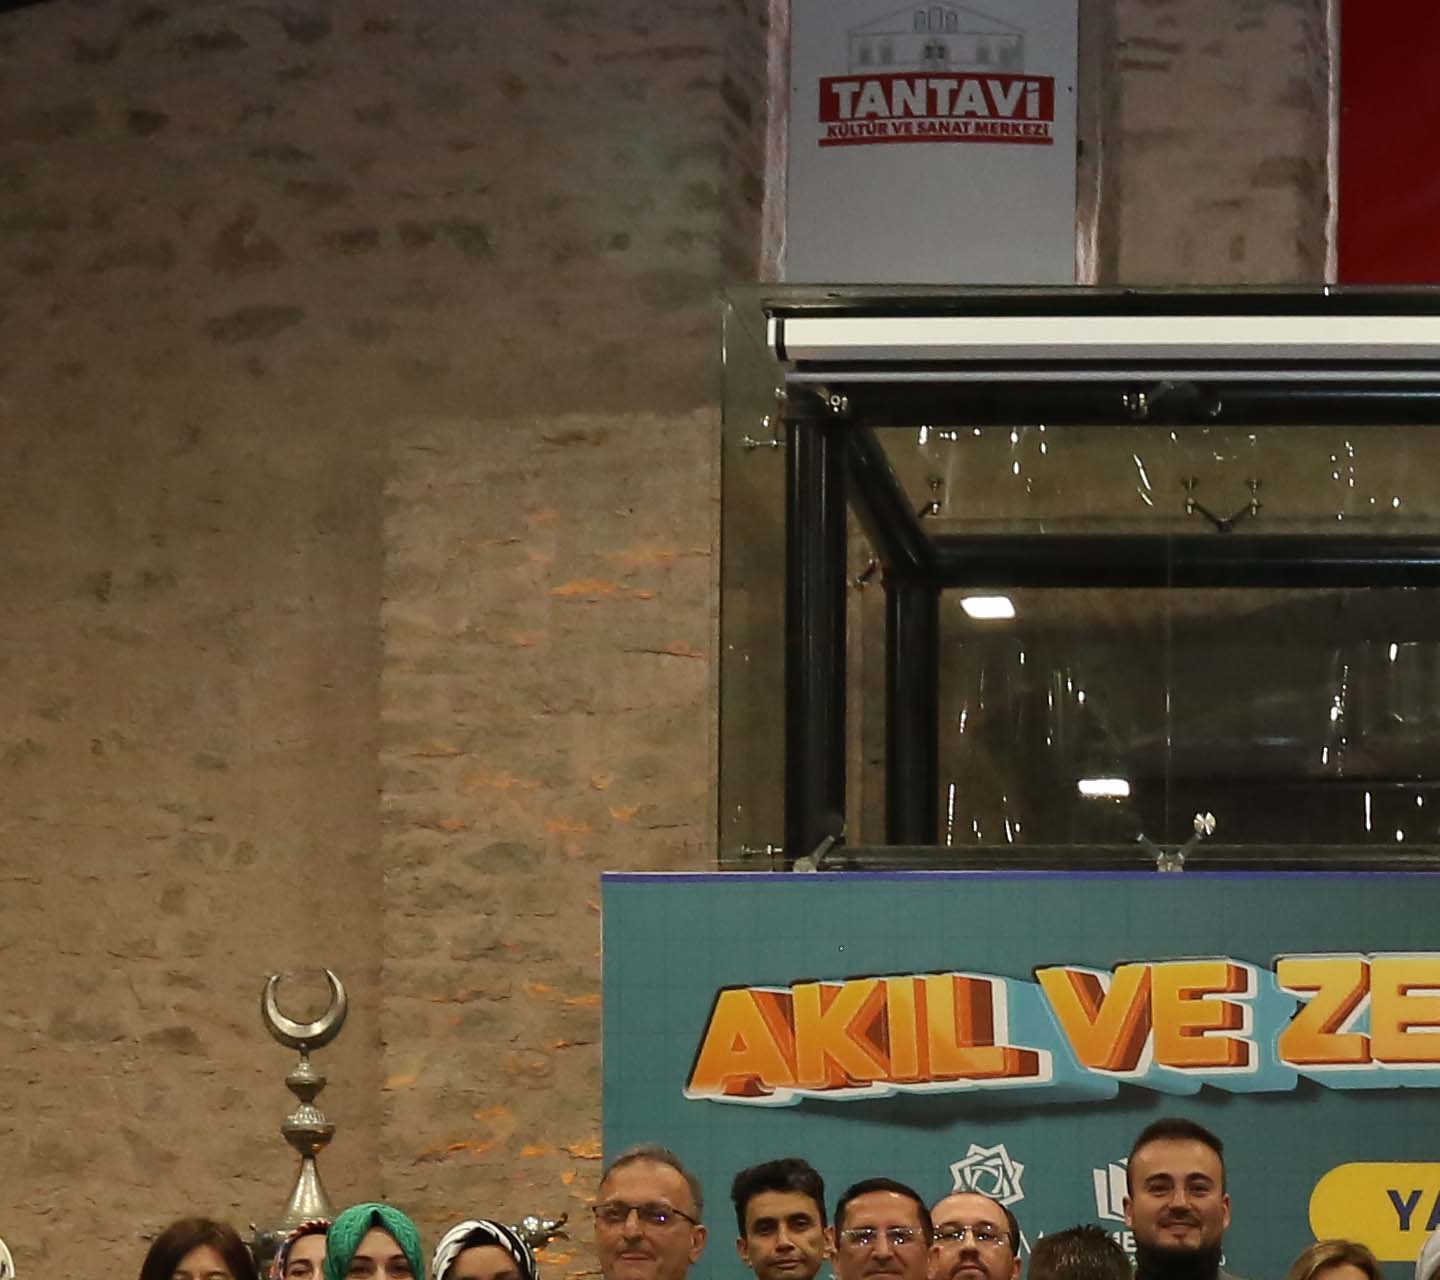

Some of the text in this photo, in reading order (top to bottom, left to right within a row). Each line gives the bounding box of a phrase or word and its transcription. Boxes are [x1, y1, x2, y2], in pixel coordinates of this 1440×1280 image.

[826, 120, 1049, 138] KÜLTÜR VE SANAT MERKEZİ
[687, 972, 1042, 1096] AKIL
[1036, 960, 1252, 1072] VE
